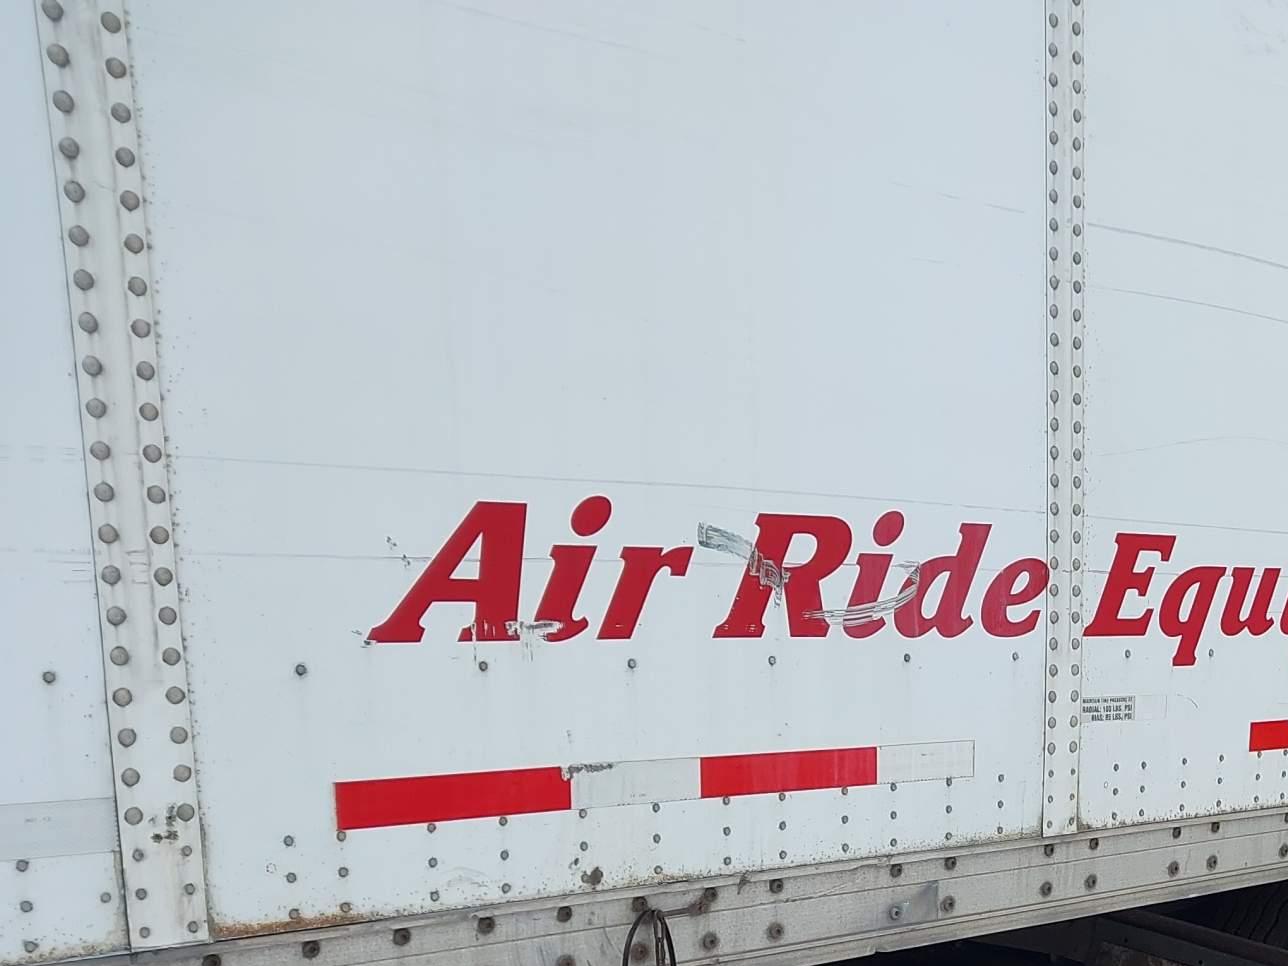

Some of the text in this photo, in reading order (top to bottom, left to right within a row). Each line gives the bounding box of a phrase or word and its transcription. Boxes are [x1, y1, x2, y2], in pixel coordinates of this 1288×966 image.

[368, 496, 692, 642] Air
[713, 511, 1049, 638] Ride
[1124, 704, 1133, 712] PSI
